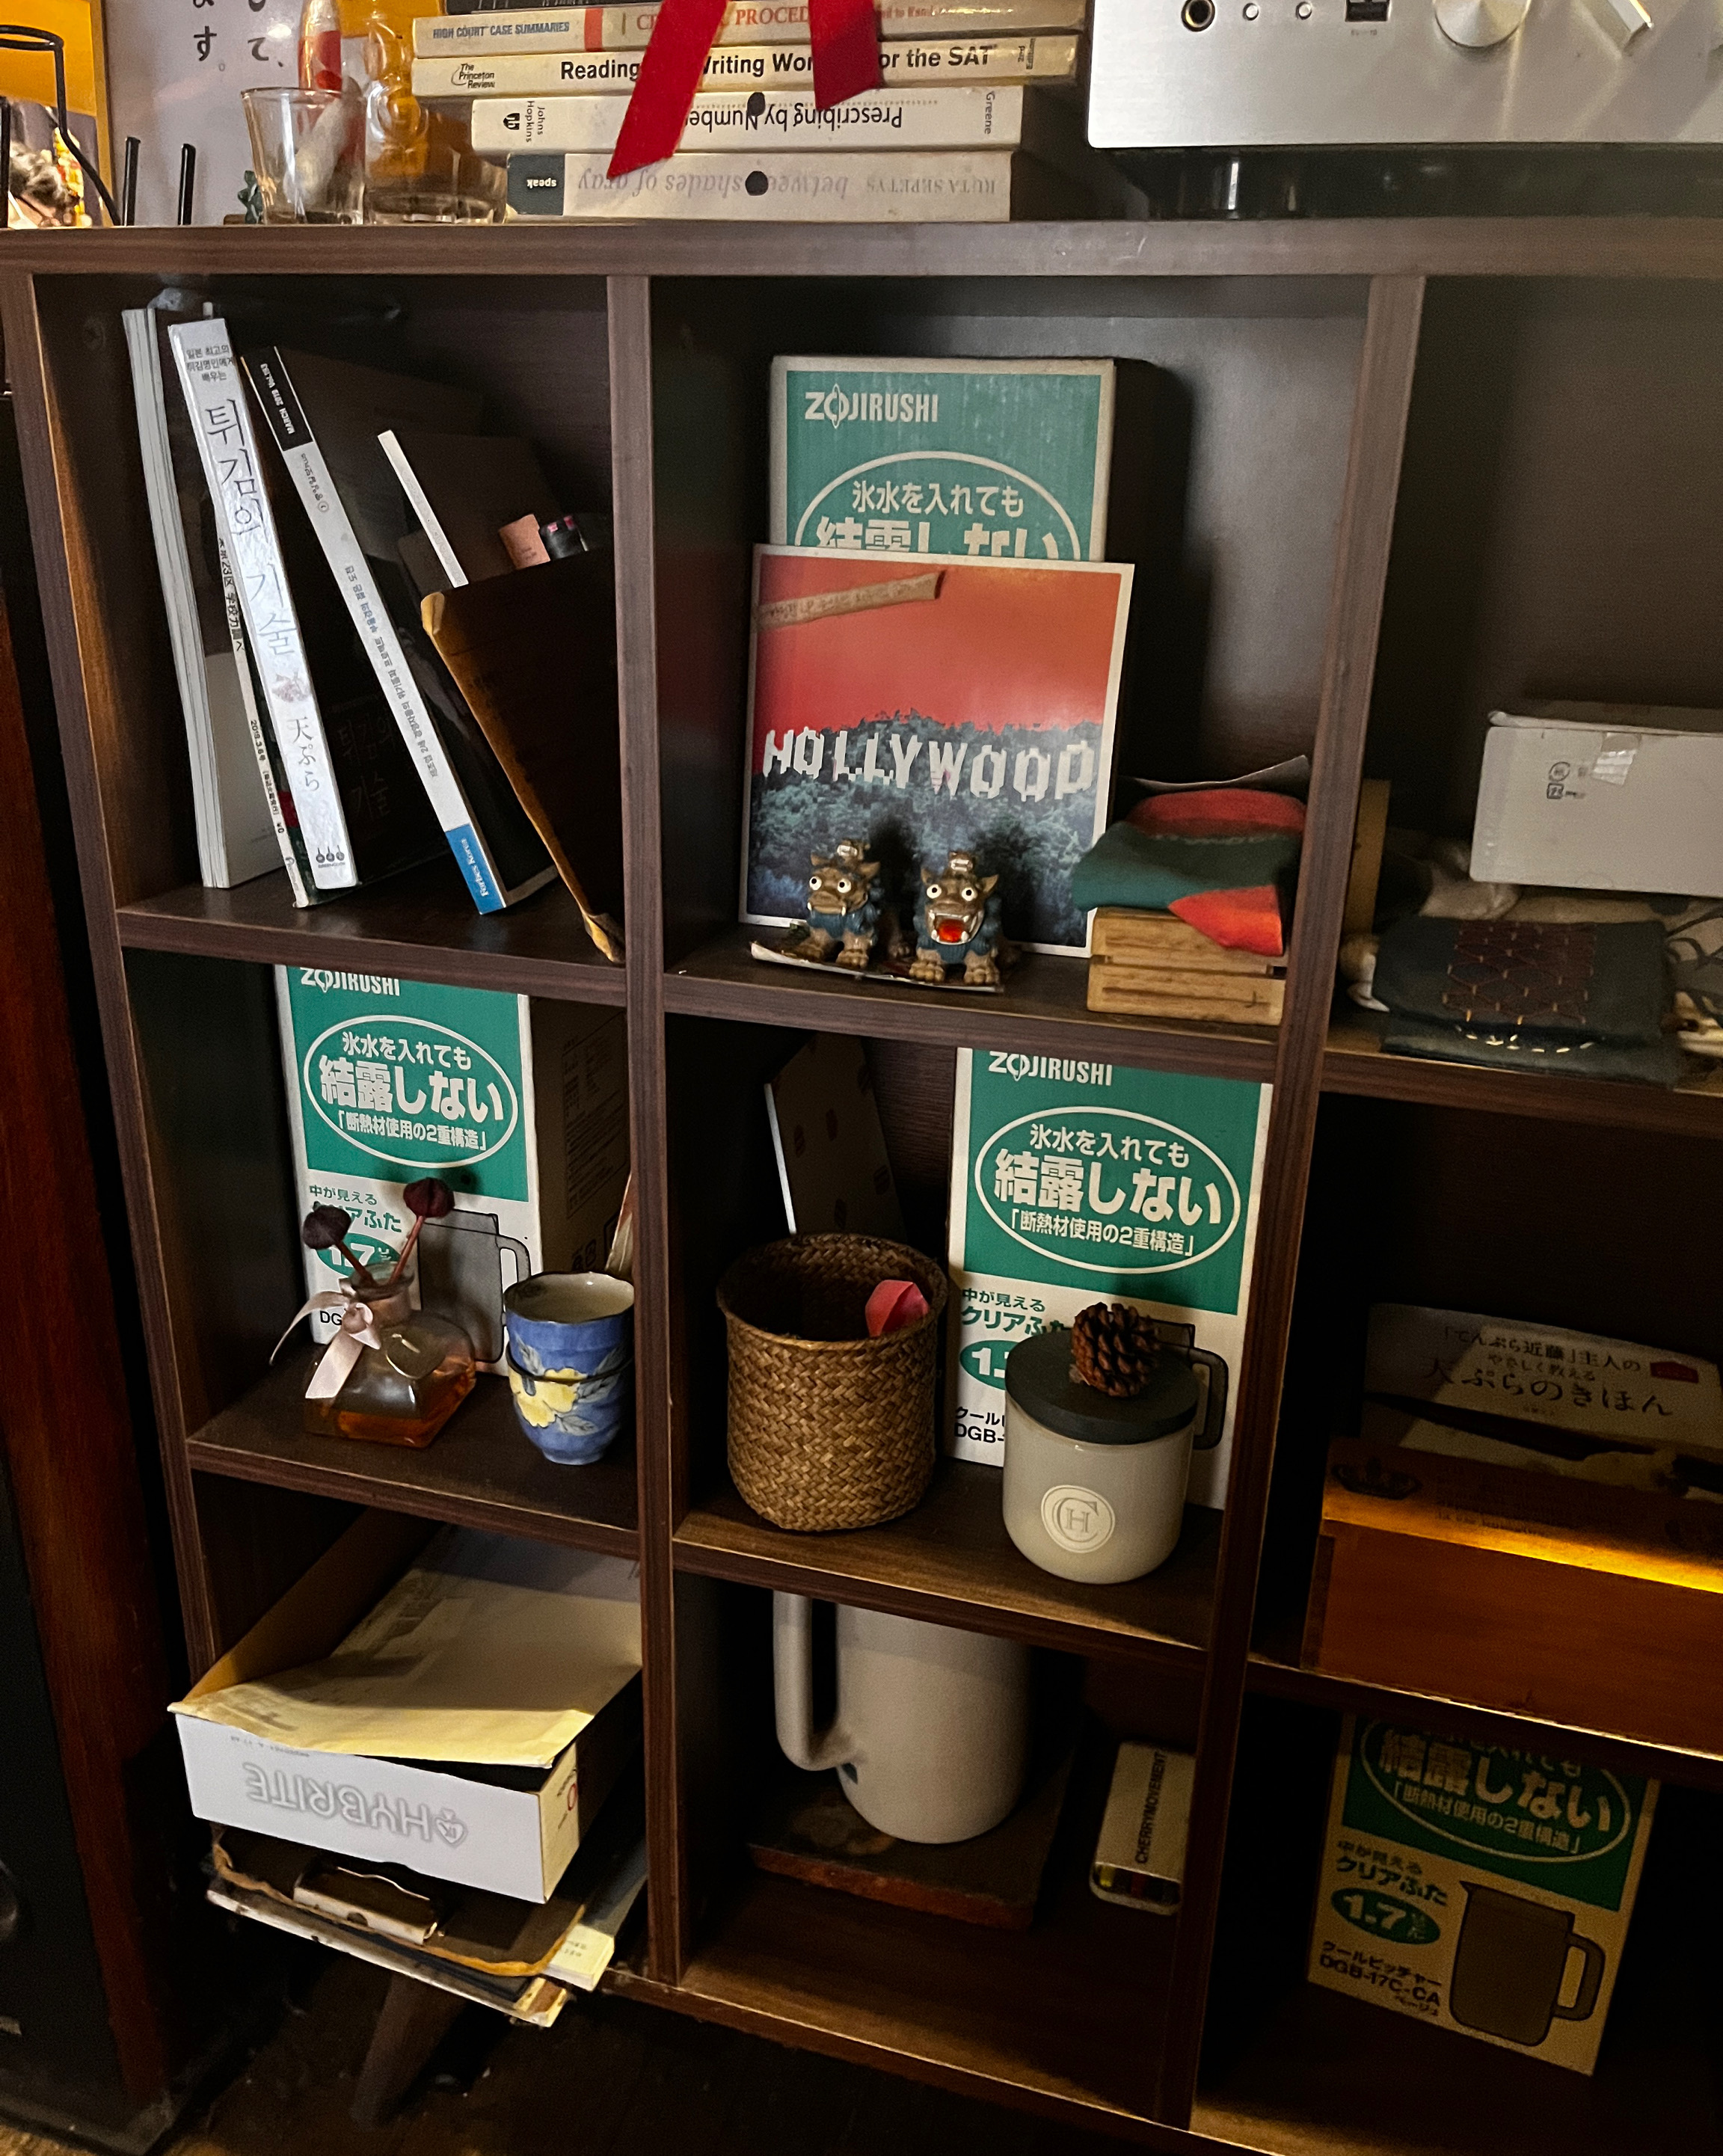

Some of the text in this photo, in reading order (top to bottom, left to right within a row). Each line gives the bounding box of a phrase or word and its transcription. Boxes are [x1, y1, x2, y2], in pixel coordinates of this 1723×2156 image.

[433, 22, 570, 38] HIGH COURT CASE SUMMARIES
[735, 6, 809, 25] PROCED
[458, 71, 494, 80] Princeton
[461, 63, 474, 72] The
[561, 60, 640, 82] Reading
[703, 55, 764, 77] riting
[878, 53, 900, 68] or
[906, 49, 941, 67] the
[467, 79, 495, 88] Review
[526, 101, 535, 142] Hopkins
[686, 104, 903, 132] Prescribing by Numbe
[984, 90, 995, 135] Greene
[526, 179, 557, 188] speak
[634, 173, 657, 194] of
[666, 172, 743, 194] shades
[768, 176, 848, 199] betwee
[866, 177, 995, 194] RUTA SEPETYS
[202, 371, 227, 382] 배우는
[270, 388, 284, 406] 2019
[805, 382, 939, 429] ZOJIRUSHI
[278, 408, 295, 435] MARCH
[851, 479, 1025, 517] 氷水を入れても
[206, 398, 298, 657] 튀김의 기술
[286, 716, 320, 792] 天ぷら
[763, 727, 1096, 803] HOLLYWOOD
[470, 864, 490, 897] Forbes
[342, 1031, 472, 1071] 氷水を入れても
[989, 1051, 1113, 1087] ZOJIRUSHI
[319, 1054, 504, 1123] 結露しない
[338, 1111, 487, 1151] 「断熱材使用の2重構造」
[1030, 1123, 1190, 1168] 氷水を入れても
[309, 1185, 378, 1206] 中が見える
[993, 1148, 1223, 1226] 結露しない
[313, 1201, 402, 1233] アふた
[1010, 1208, 1194, 1257] 「断熱材使用の2重構造」
[962, 1287, 1046, 1313] 中が見える
[319, 1310, 343, 1326] DG
[971, 1347, 1007, 1378] 1.
[953, 1426, 1004, 1444] DGB-
[1378, 1728, 1612, 1832] 結露しない
[242, 1762, 432, 1843] HYBRITE
[1336, 1856, 1449, 1908] クリアふた
[1343, 1895, 1407, 1931] 1.7
[1320, 1953, 1440, 2007] DGB-17C-CA
